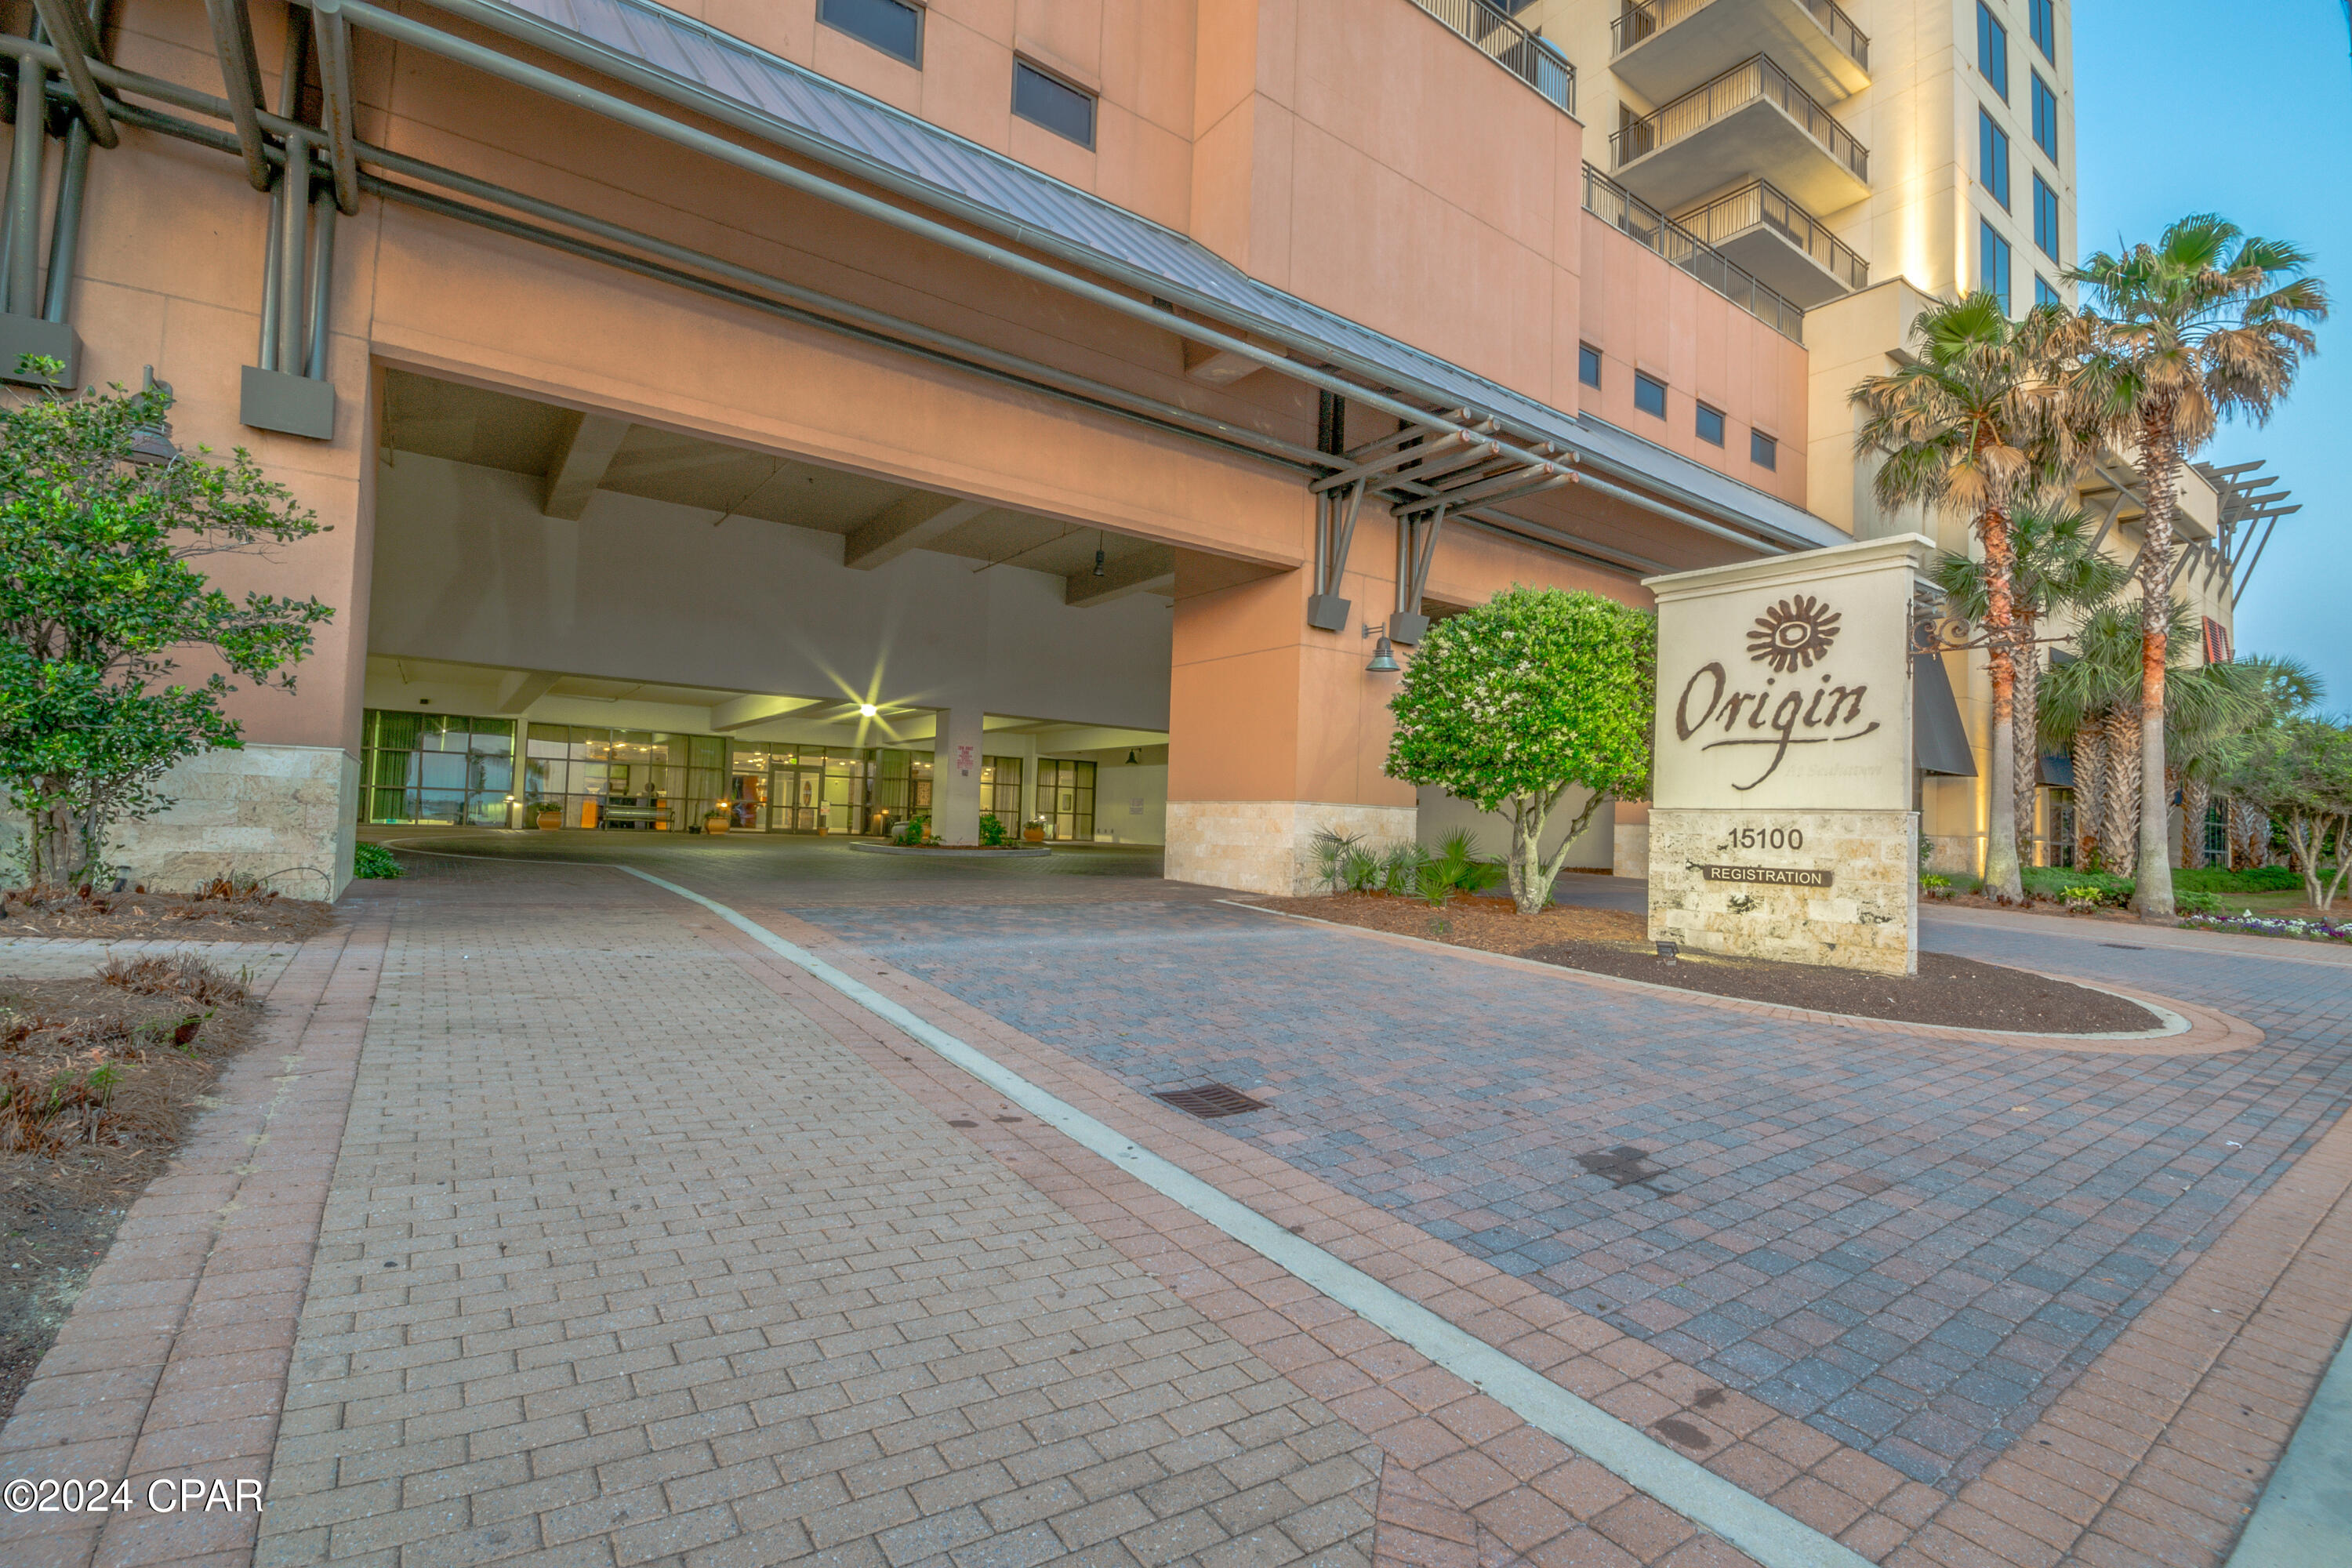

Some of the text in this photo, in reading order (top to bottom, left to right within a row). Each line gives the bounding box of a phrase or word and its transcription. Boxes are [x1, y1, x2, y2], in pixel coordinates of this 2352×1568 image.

[1676, 662, 1880, 790] Origin
[1728, 827, 1804, 850] 15100
[1710, 867, 1822, 885] REGISTRATION
